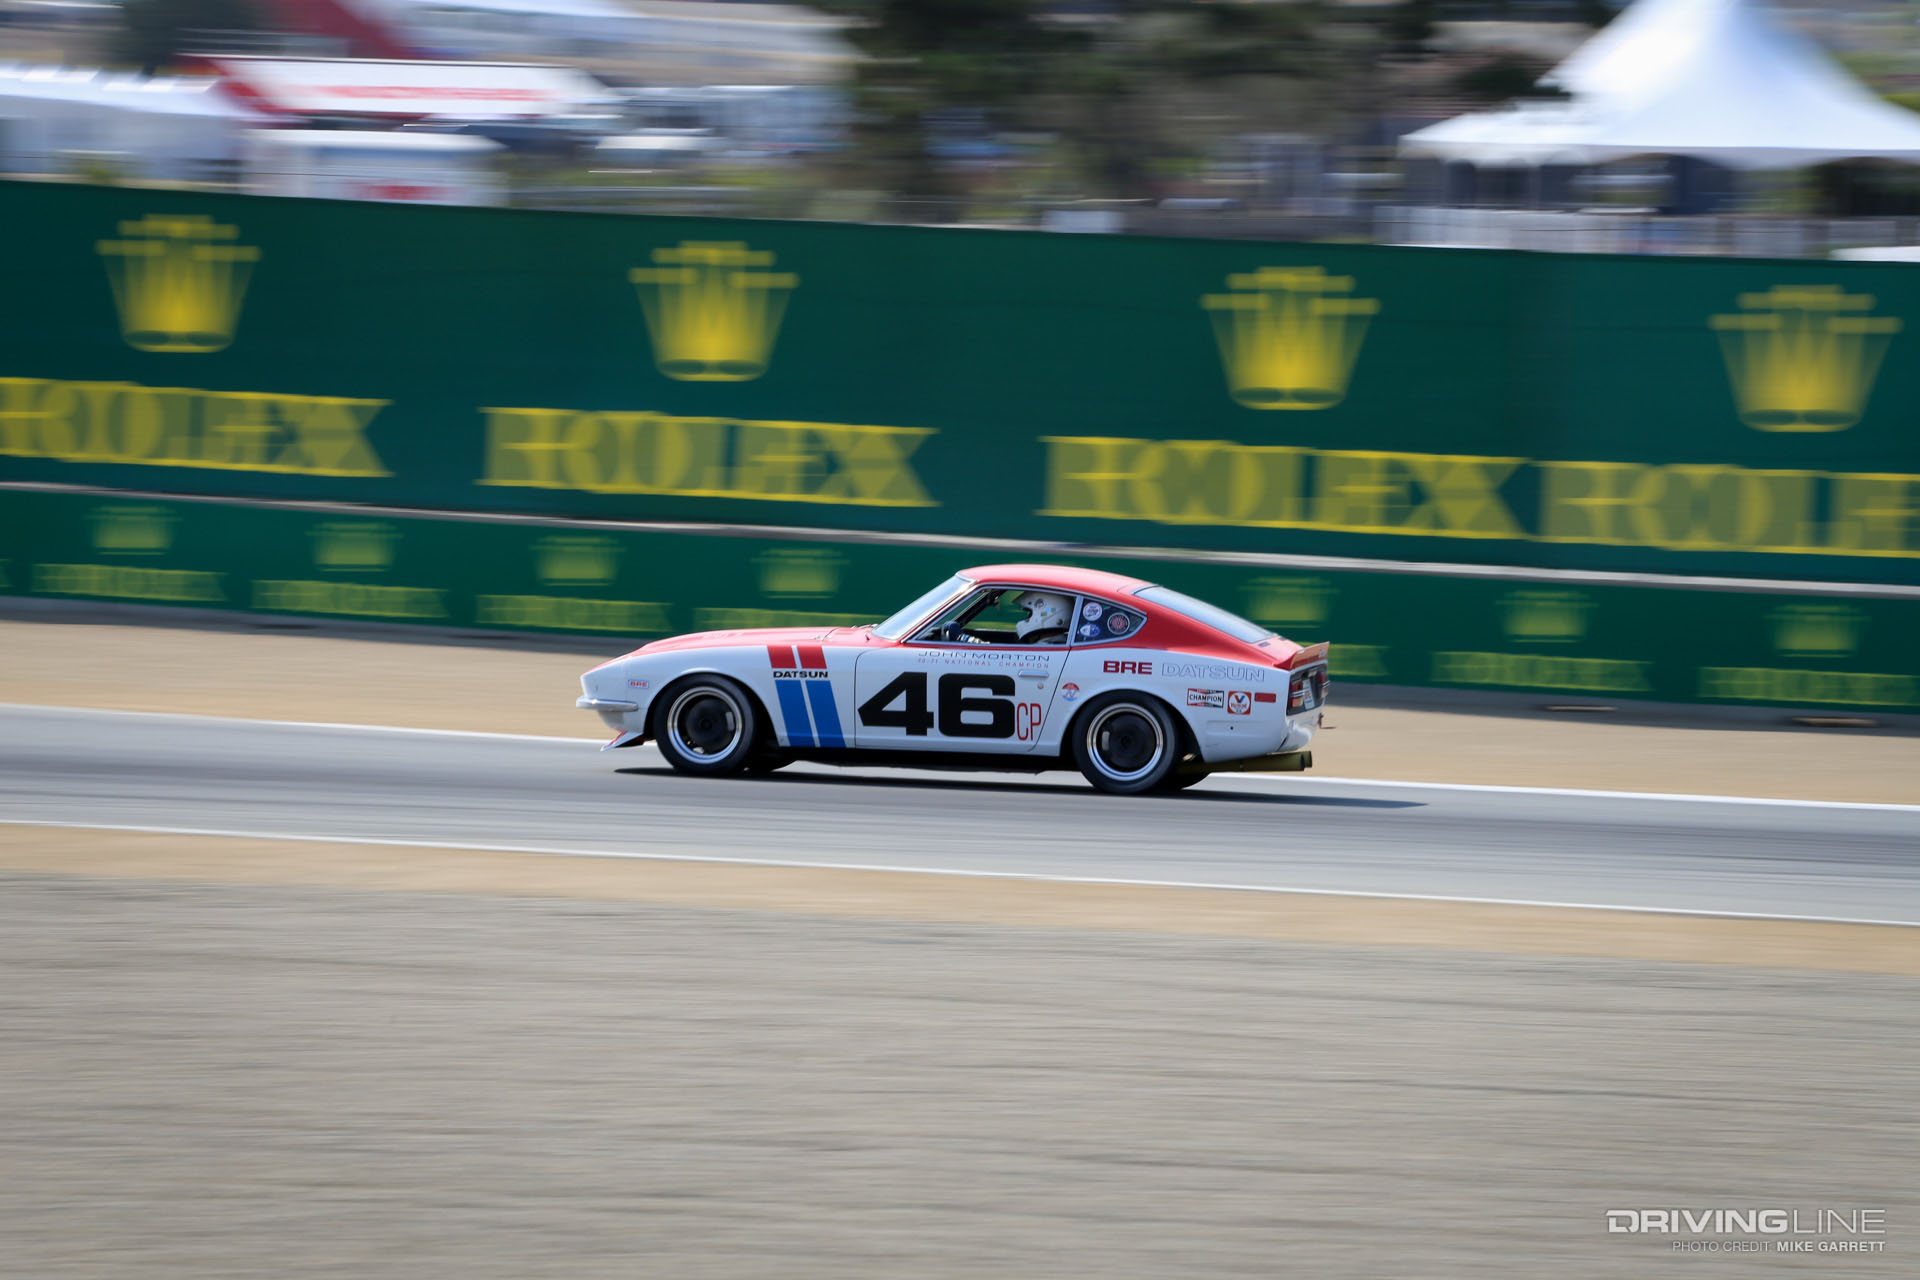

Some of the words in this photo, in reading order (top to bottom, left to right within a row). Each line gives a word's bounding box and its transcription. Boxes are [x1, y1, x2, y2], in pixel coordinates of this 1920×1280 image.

[474, 406, 942, 508] ROLEX
[1034, 435, 1535, 541] ROLEX
[972, 654, 1050, 662] MORTON
[1103, 661, 1152, 675] BRE
[1162, 663, 1265, 682] DATSUN
[773, 671, 828, 679] DATSUN
[857, 672, 1016, 738] 46
[1189, 694, 1222, 703] CHAMPION
[1017, 702, 1042, 741] CP
